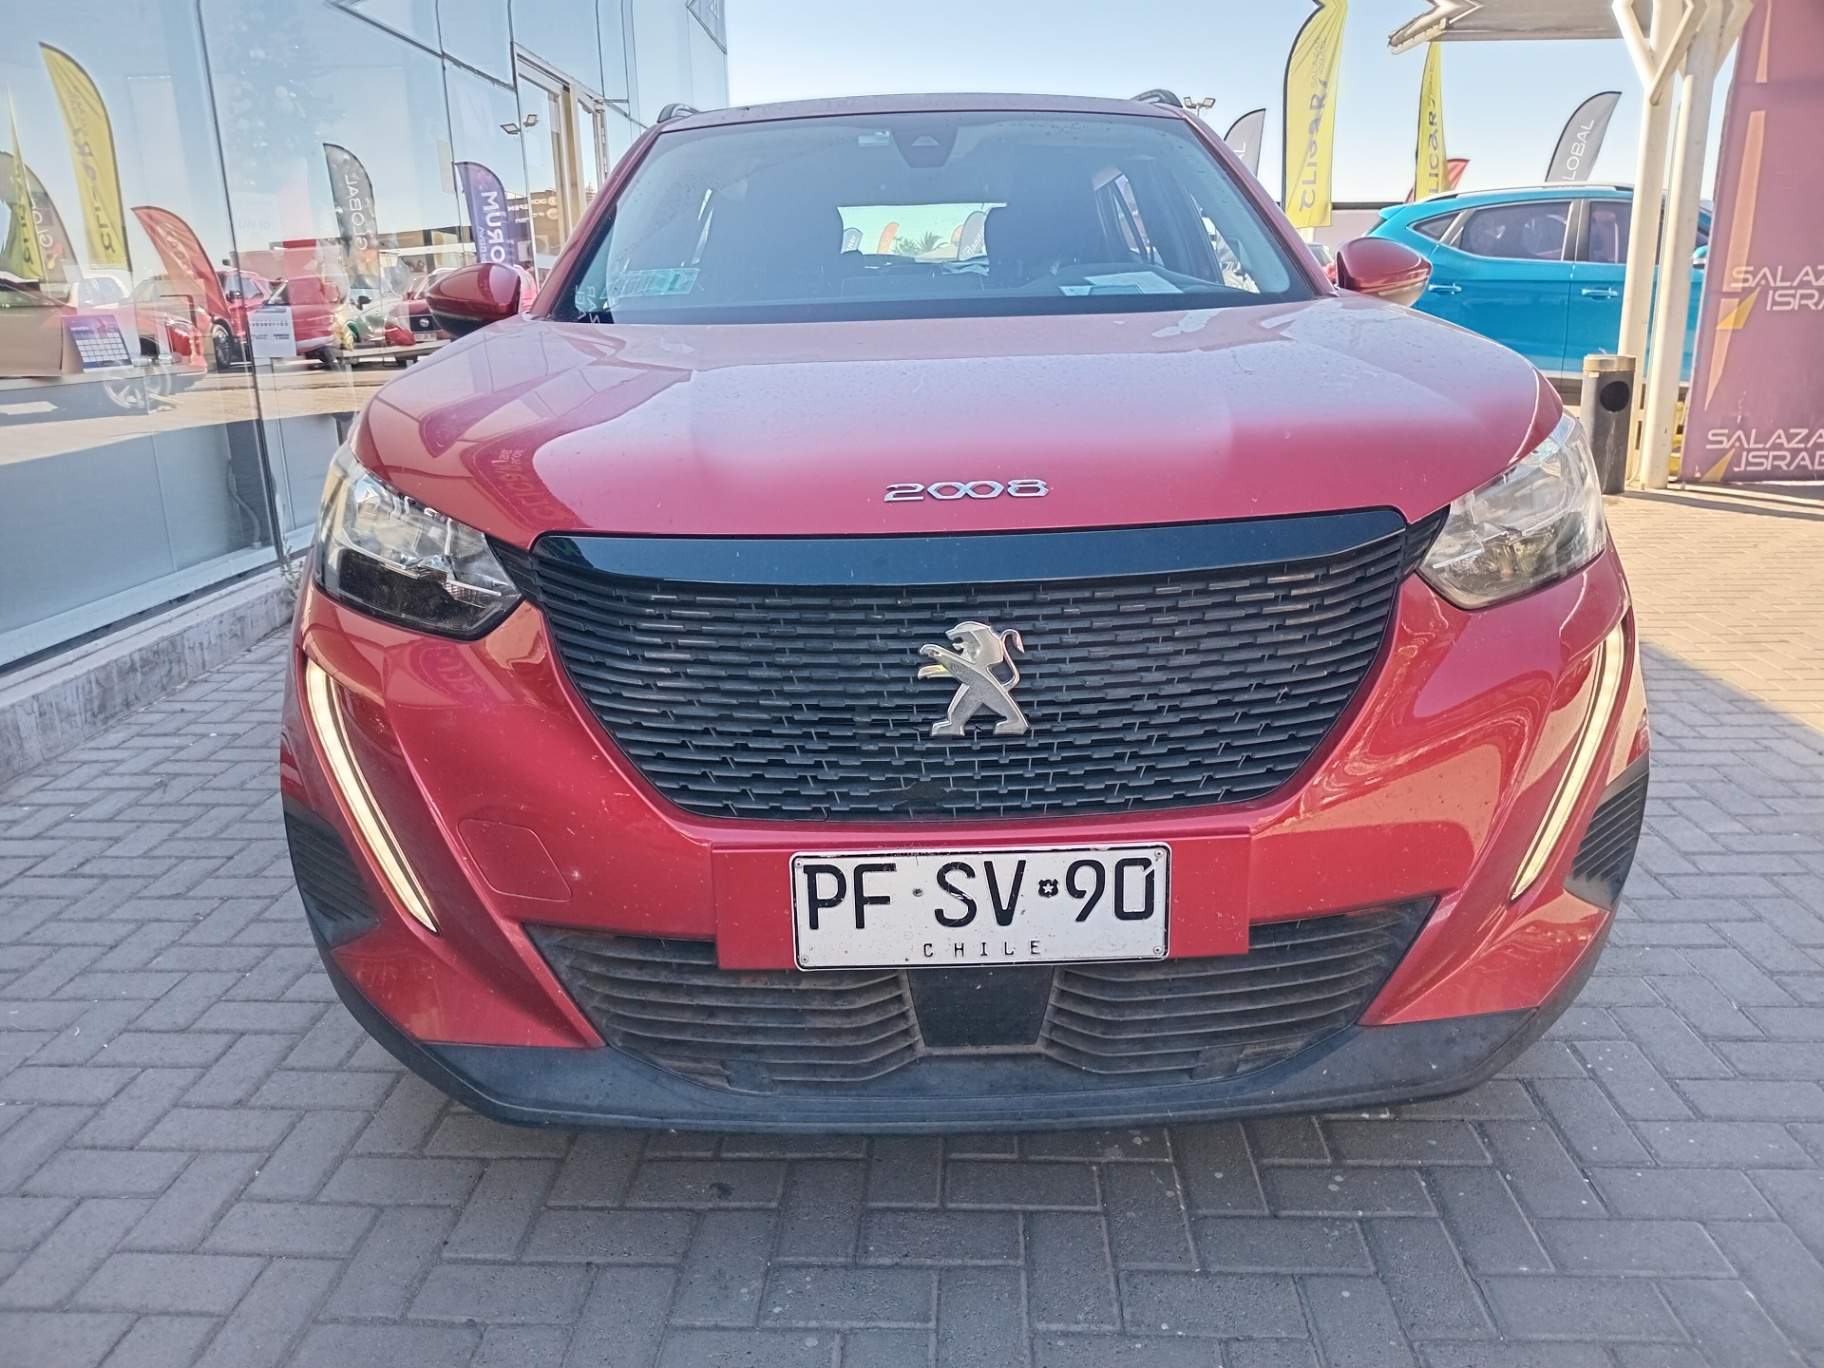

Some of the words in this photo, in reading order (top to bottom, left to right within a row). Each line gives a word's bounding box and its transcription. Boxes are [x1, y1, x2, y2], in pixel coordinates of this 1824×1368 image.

[1428, 111, 1439, 193] LICAR
[1562, 119, 1595, 181] LOBAL
[1766, 288, 1824, 312] ISR
[1705, 428, 1824, 449] SALAZA
[1740, 450, 1824, 471] ISRAE
[883, 478, 1050, 502] 2008
[923, 940, 1041, 958] CHILE
